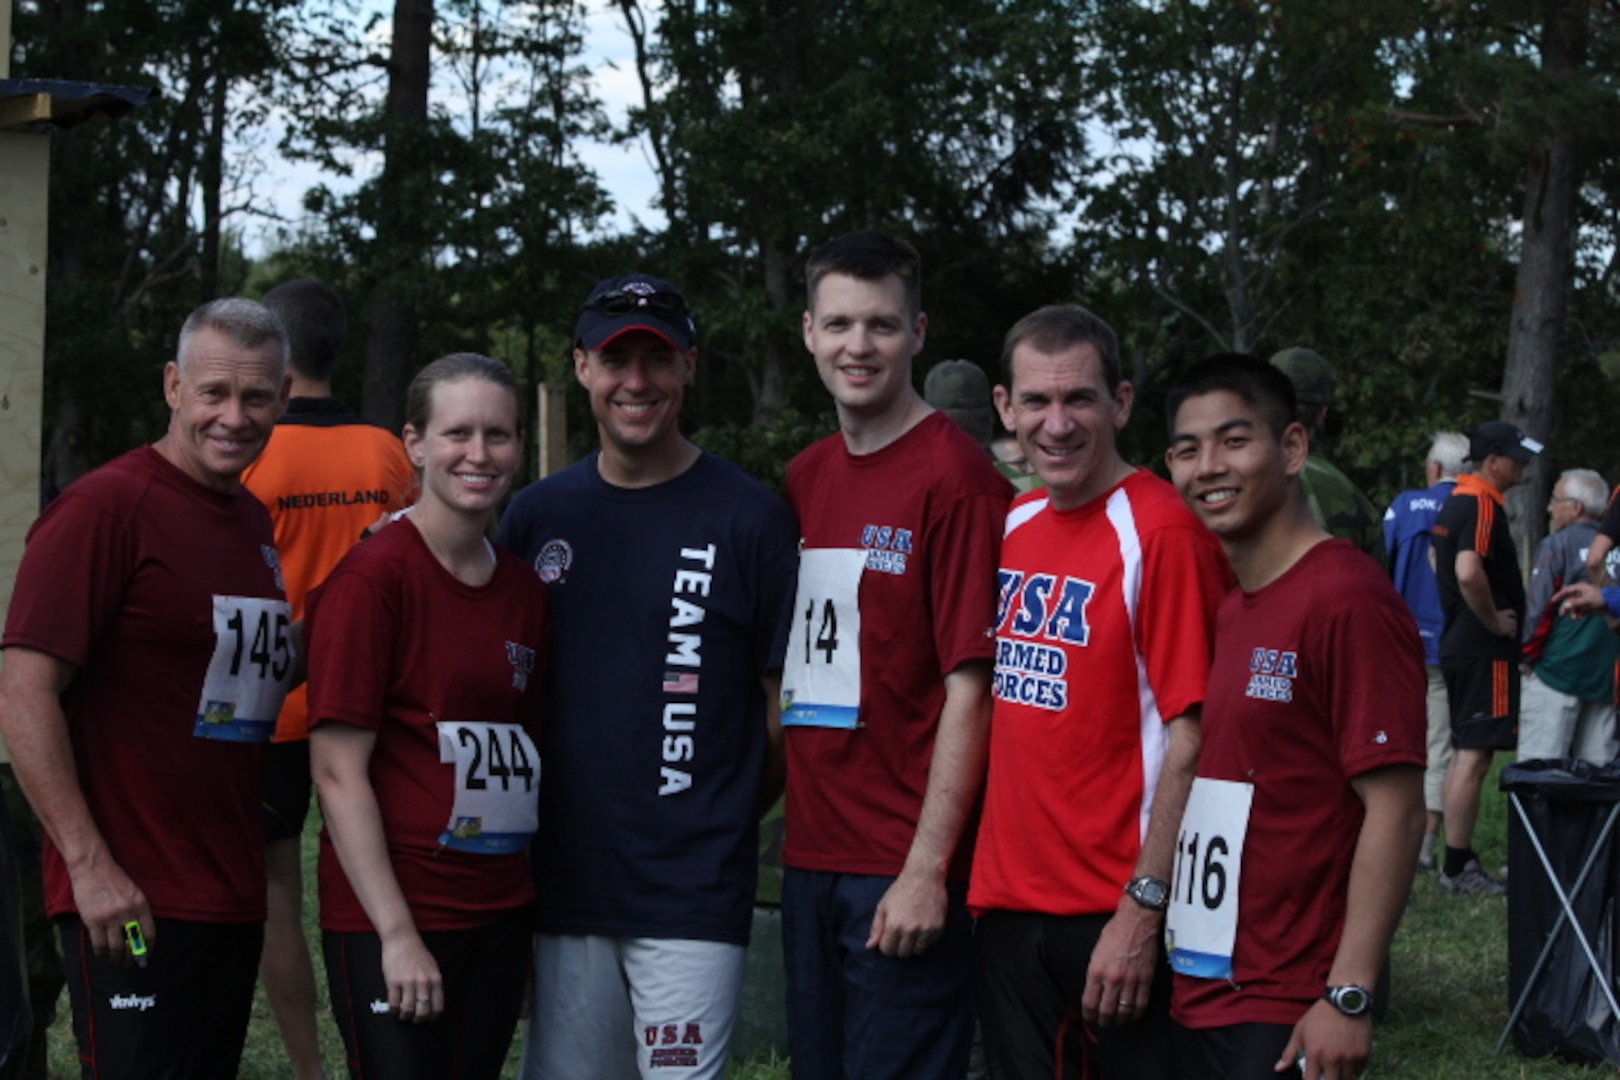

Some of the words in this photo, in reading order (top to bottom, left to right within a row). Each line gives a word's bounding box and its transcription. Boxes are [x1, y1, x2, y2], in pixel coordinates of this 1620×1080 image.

[278, 490, 390, 510] NEDERLAND
[861, 525, 912, 553] USA
[665, 543, 717, 667] TEAM
[805, 598, 839, 664] 14
[227, 608, 290, 682] 145
[996, 637, 1067, 679] RMED
[1250, 647, 1298, 679] USA
[992, 669, 1068, 712] ORCES
[457, 727, 533, 792] 244
[658, 703, 697, 796] USA
[1174, 830, 1229, 911] 116
[644, 1022, 703, 1047] USA
